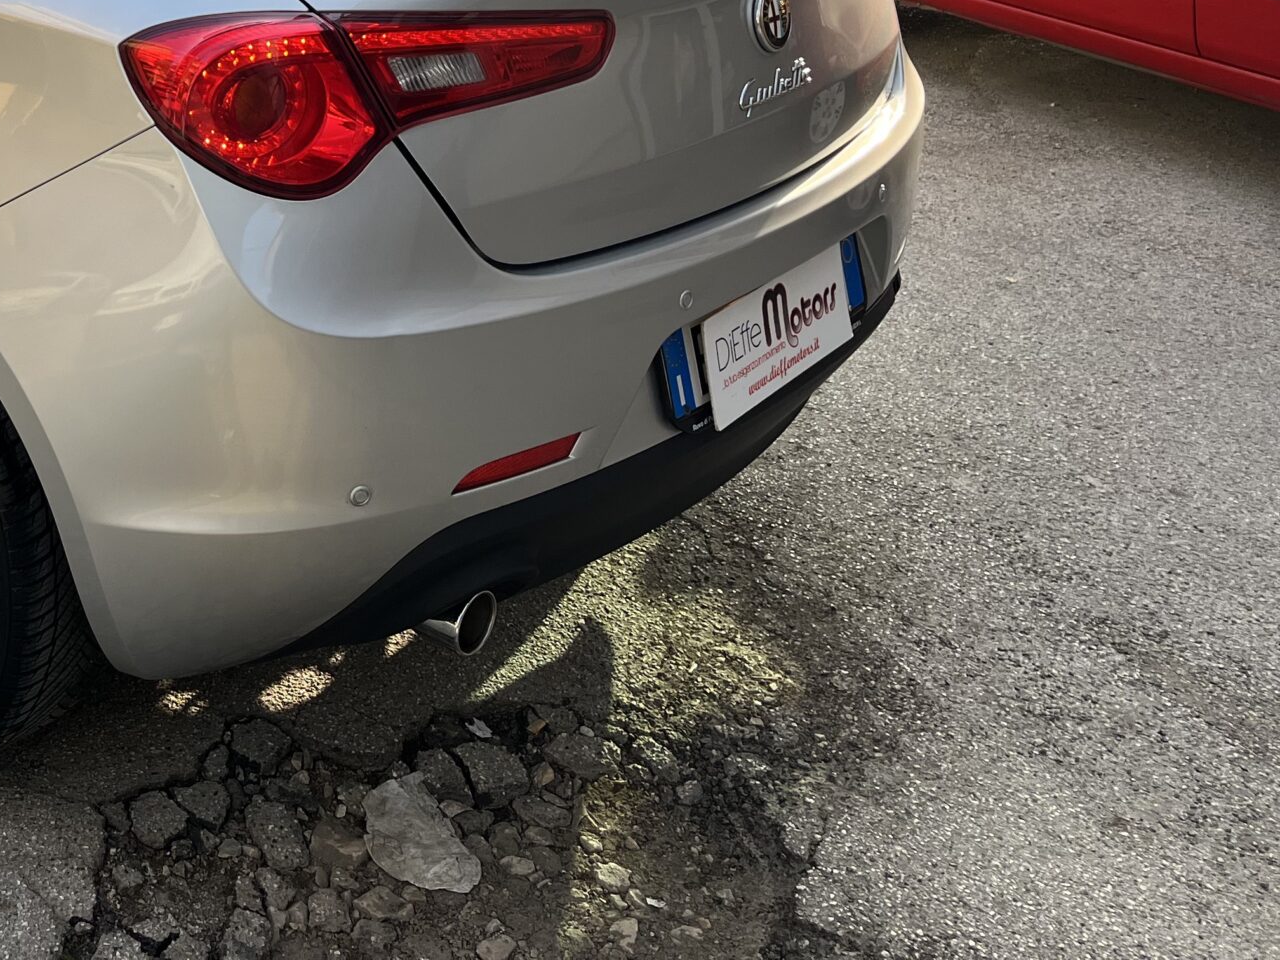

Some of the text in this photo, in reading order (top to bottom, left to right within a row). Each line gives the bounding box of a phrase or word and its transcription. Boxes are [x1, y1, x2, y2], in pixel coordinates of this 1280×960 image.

[739, 56, 812, 118] Giulietta
[715, 282, 837, 372] DiEffe Motors
[748, 337, 820, 396] www.dieffemotors.it
